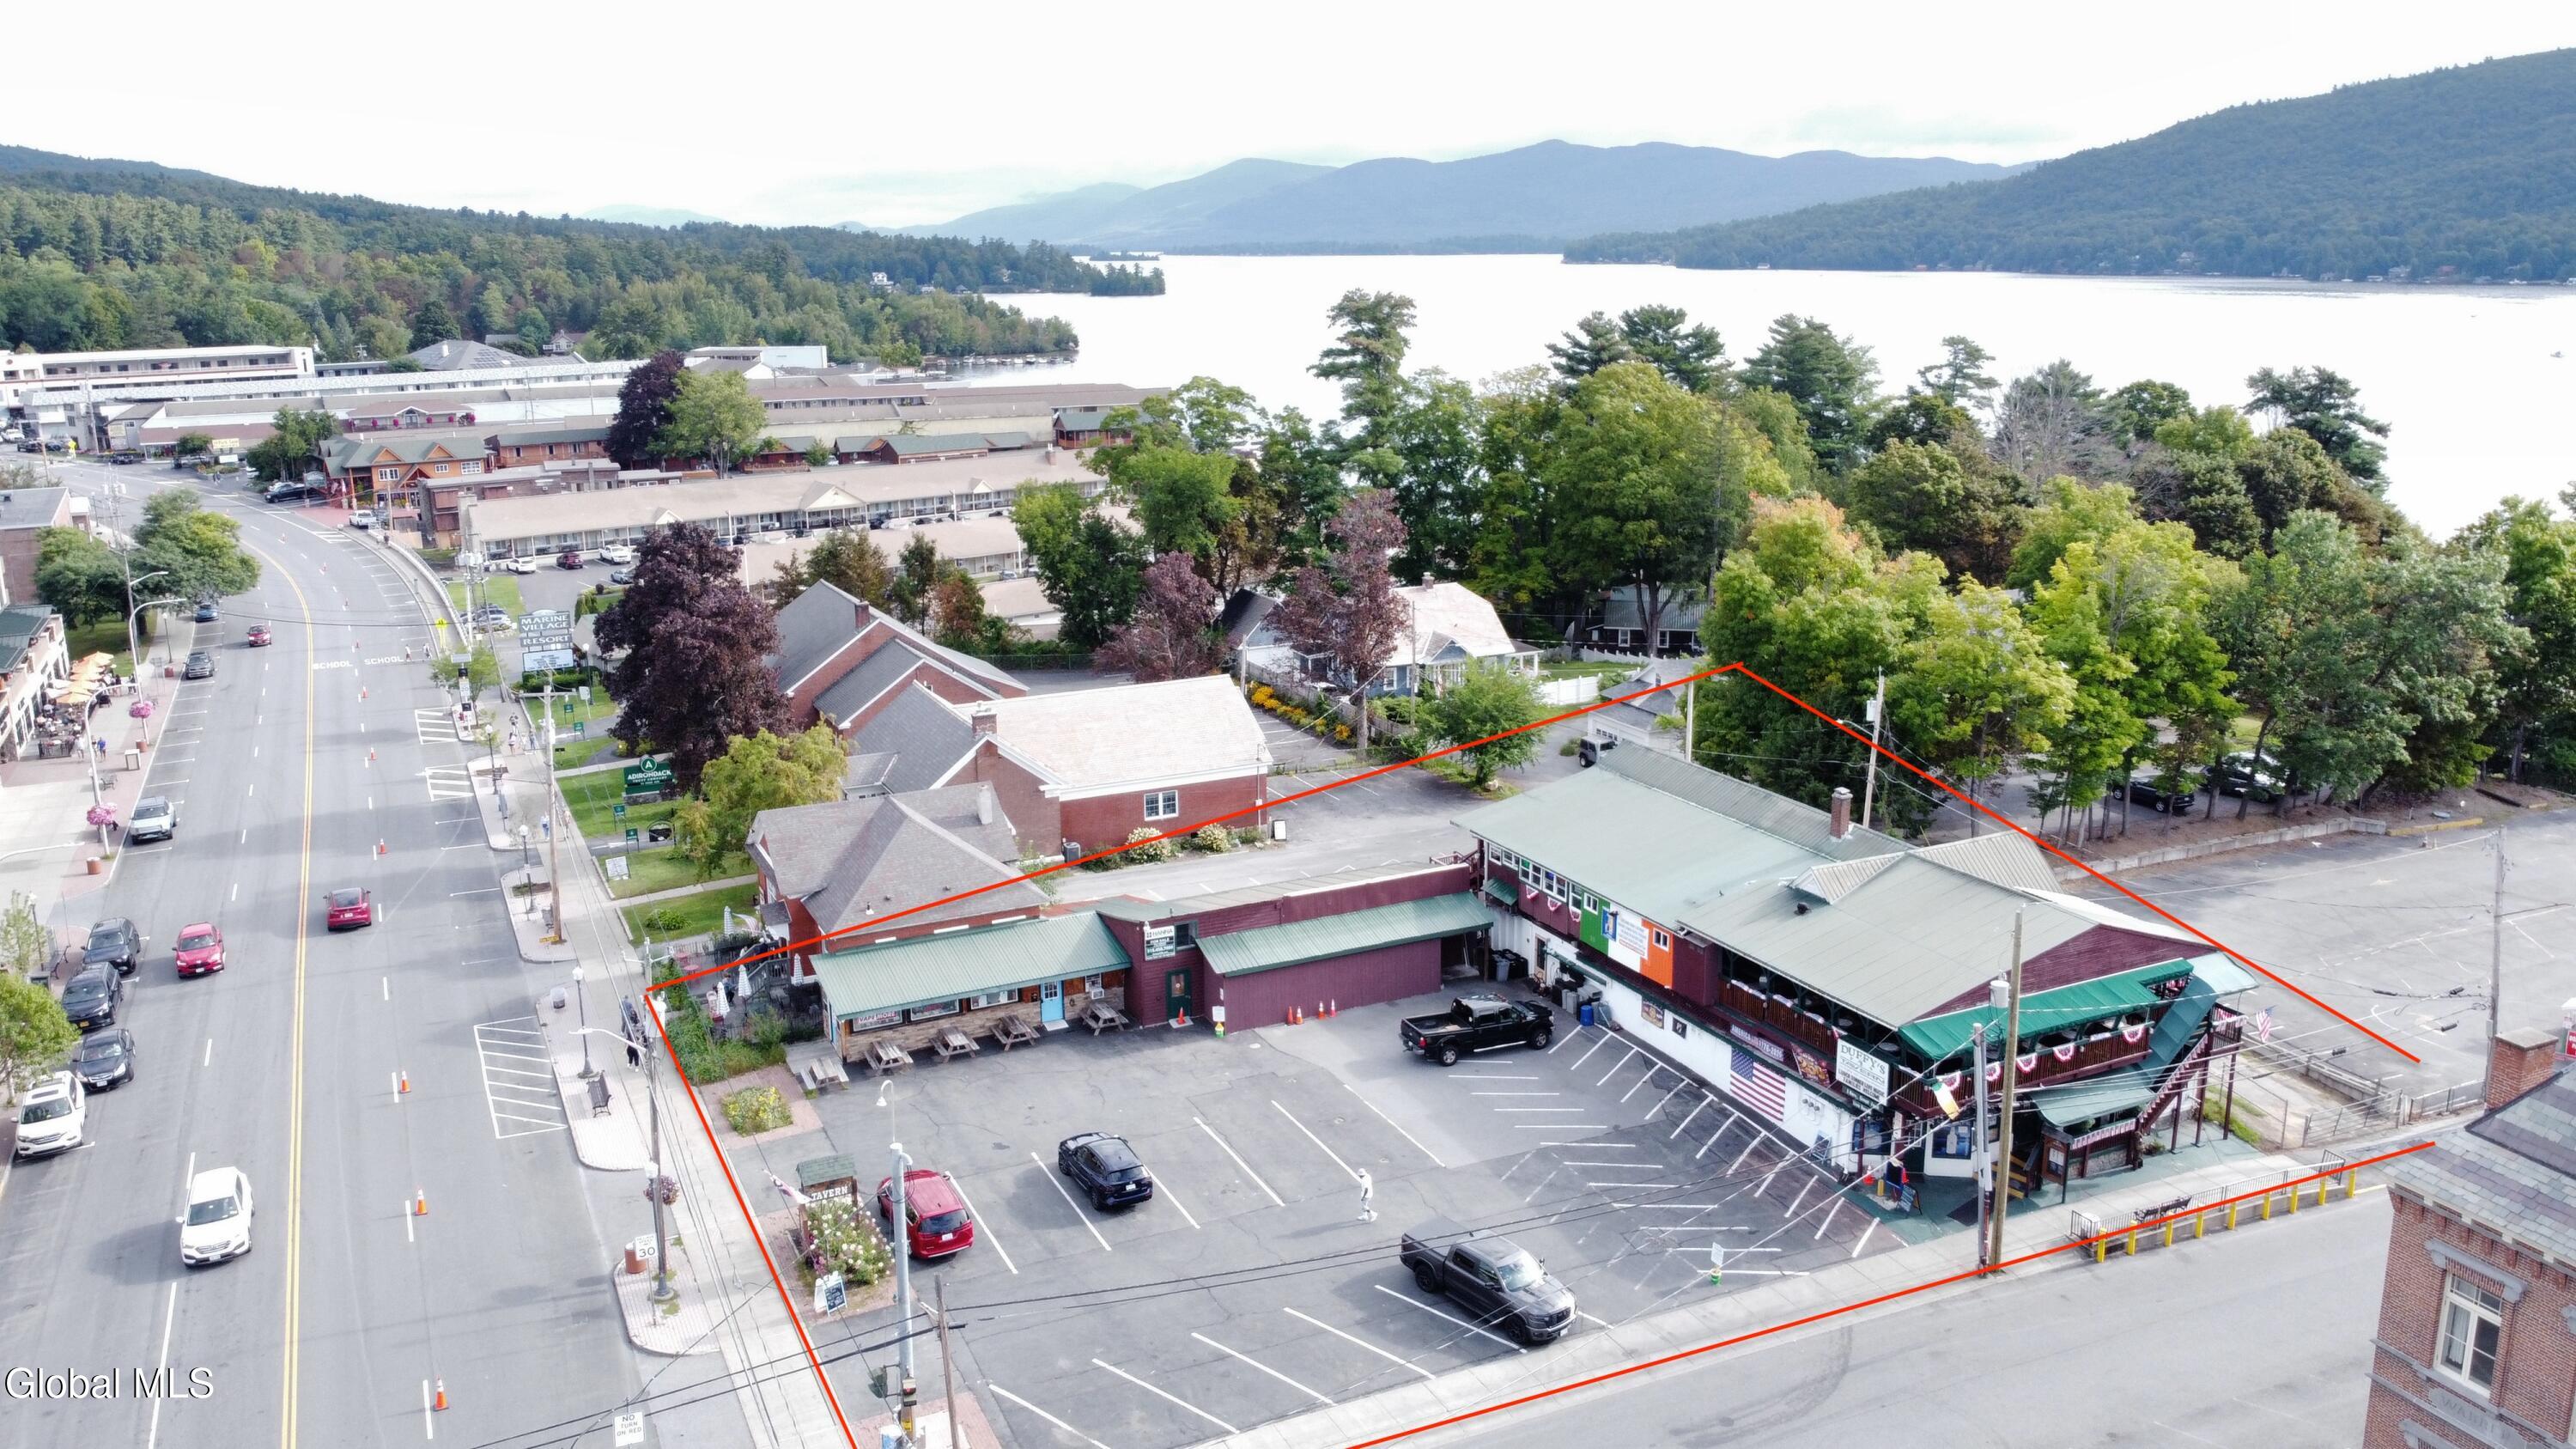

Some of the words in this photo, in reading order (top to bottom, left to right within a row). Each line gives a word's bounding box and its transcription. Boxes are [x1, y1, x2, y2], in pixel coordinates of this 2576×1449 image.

[521, 615, 568, 625] MARINE
[521, 622, 568, 631] VILLAGE
[523, 636, 570, 645] RESORT
[313, 660, 353, 670] SCHOOL
[364, 655, 404, 666] SCHOOL
[645, 760, 653, 769] A
[628, 770, 671, 780] ADIRONDACK
[1731, 1024, 1751, 1042] AMERICA
[1841, 1044, 1886, 1075] DUFFY'S
[811, 1185, 848, 1201] TAVERN
[639, 1246, 655, 1257] 30
[629, 1426, 642, 1434] RED
